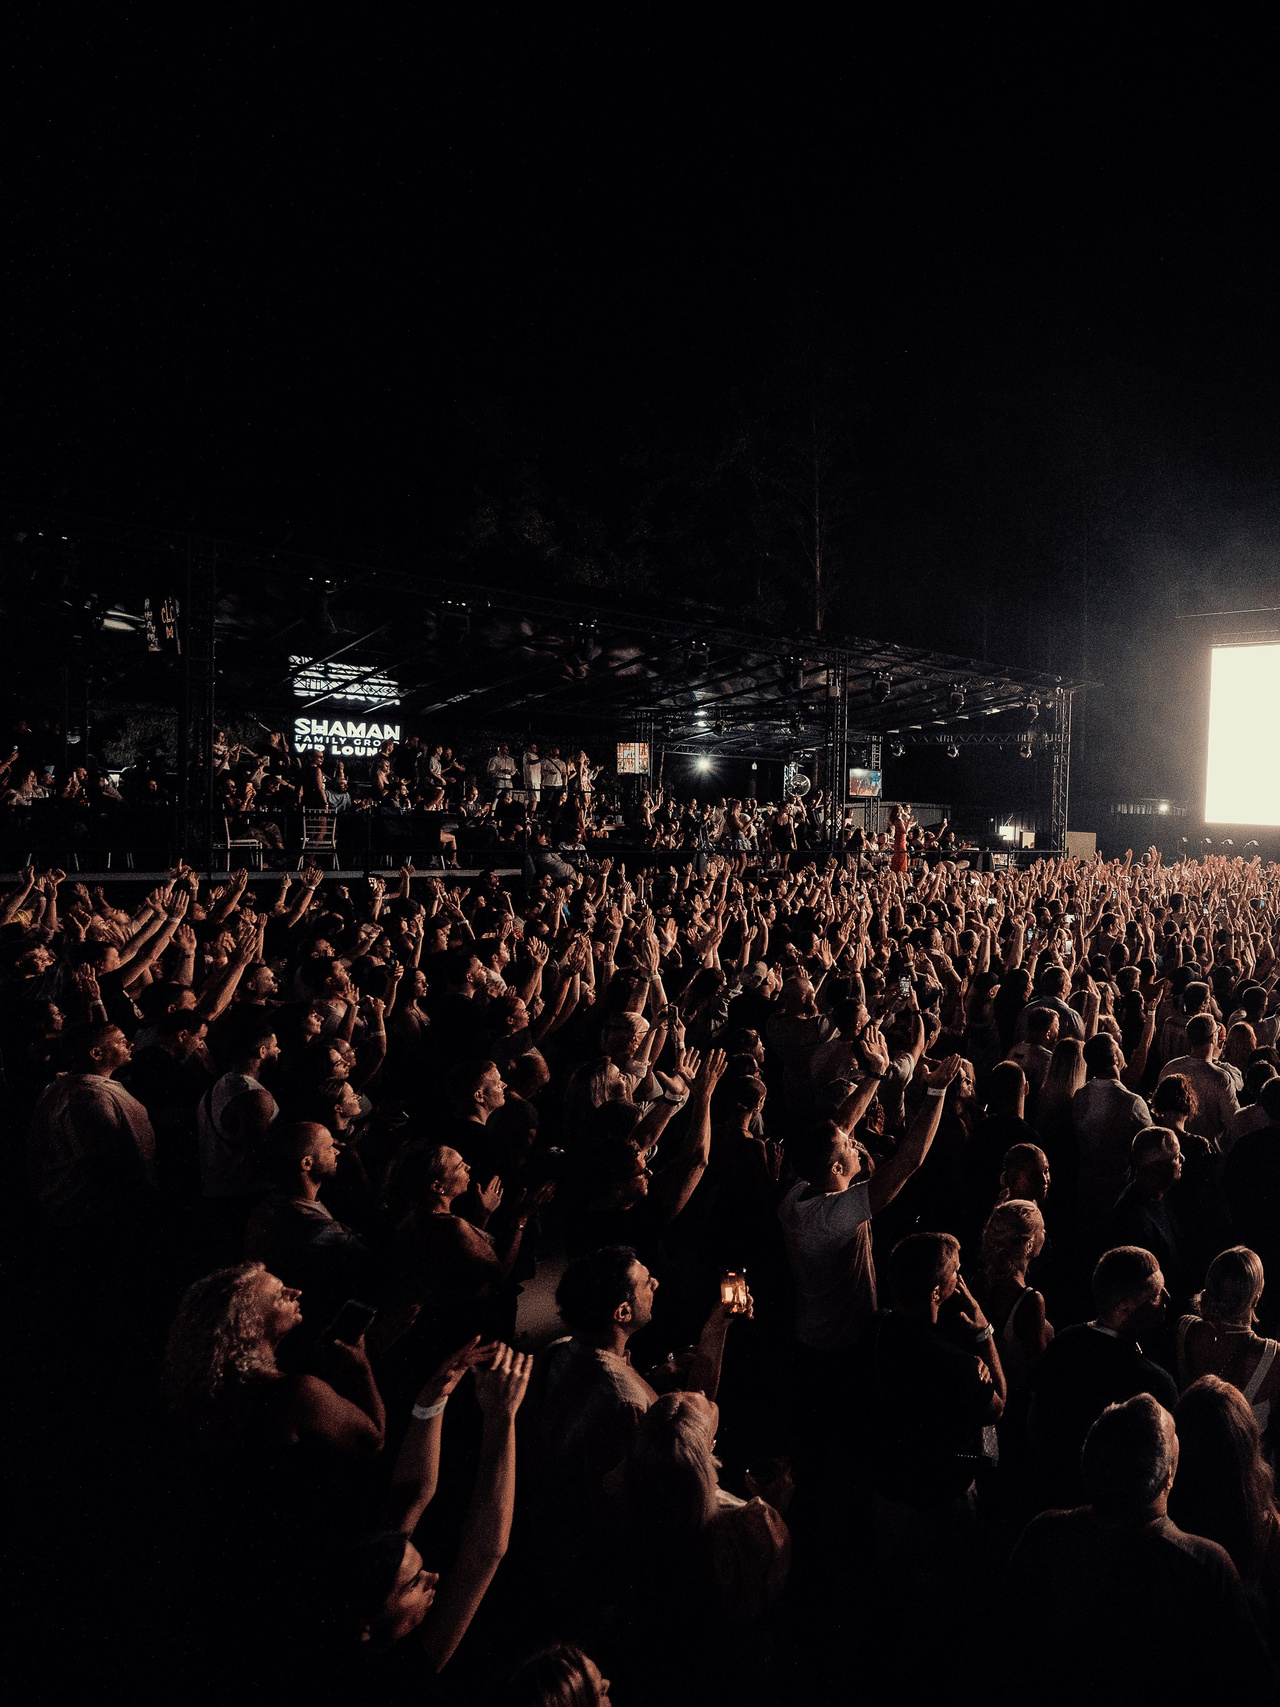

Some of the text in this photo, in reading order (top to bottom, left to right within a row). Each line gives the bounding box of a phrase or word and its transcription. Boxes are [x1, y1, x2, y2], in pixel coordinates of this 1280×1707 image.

[294, 718, 400, 740] SHAMAN
[295, 735, 399, 747] FAMILY GRO
[332, 745, 382, 757] LOUN
